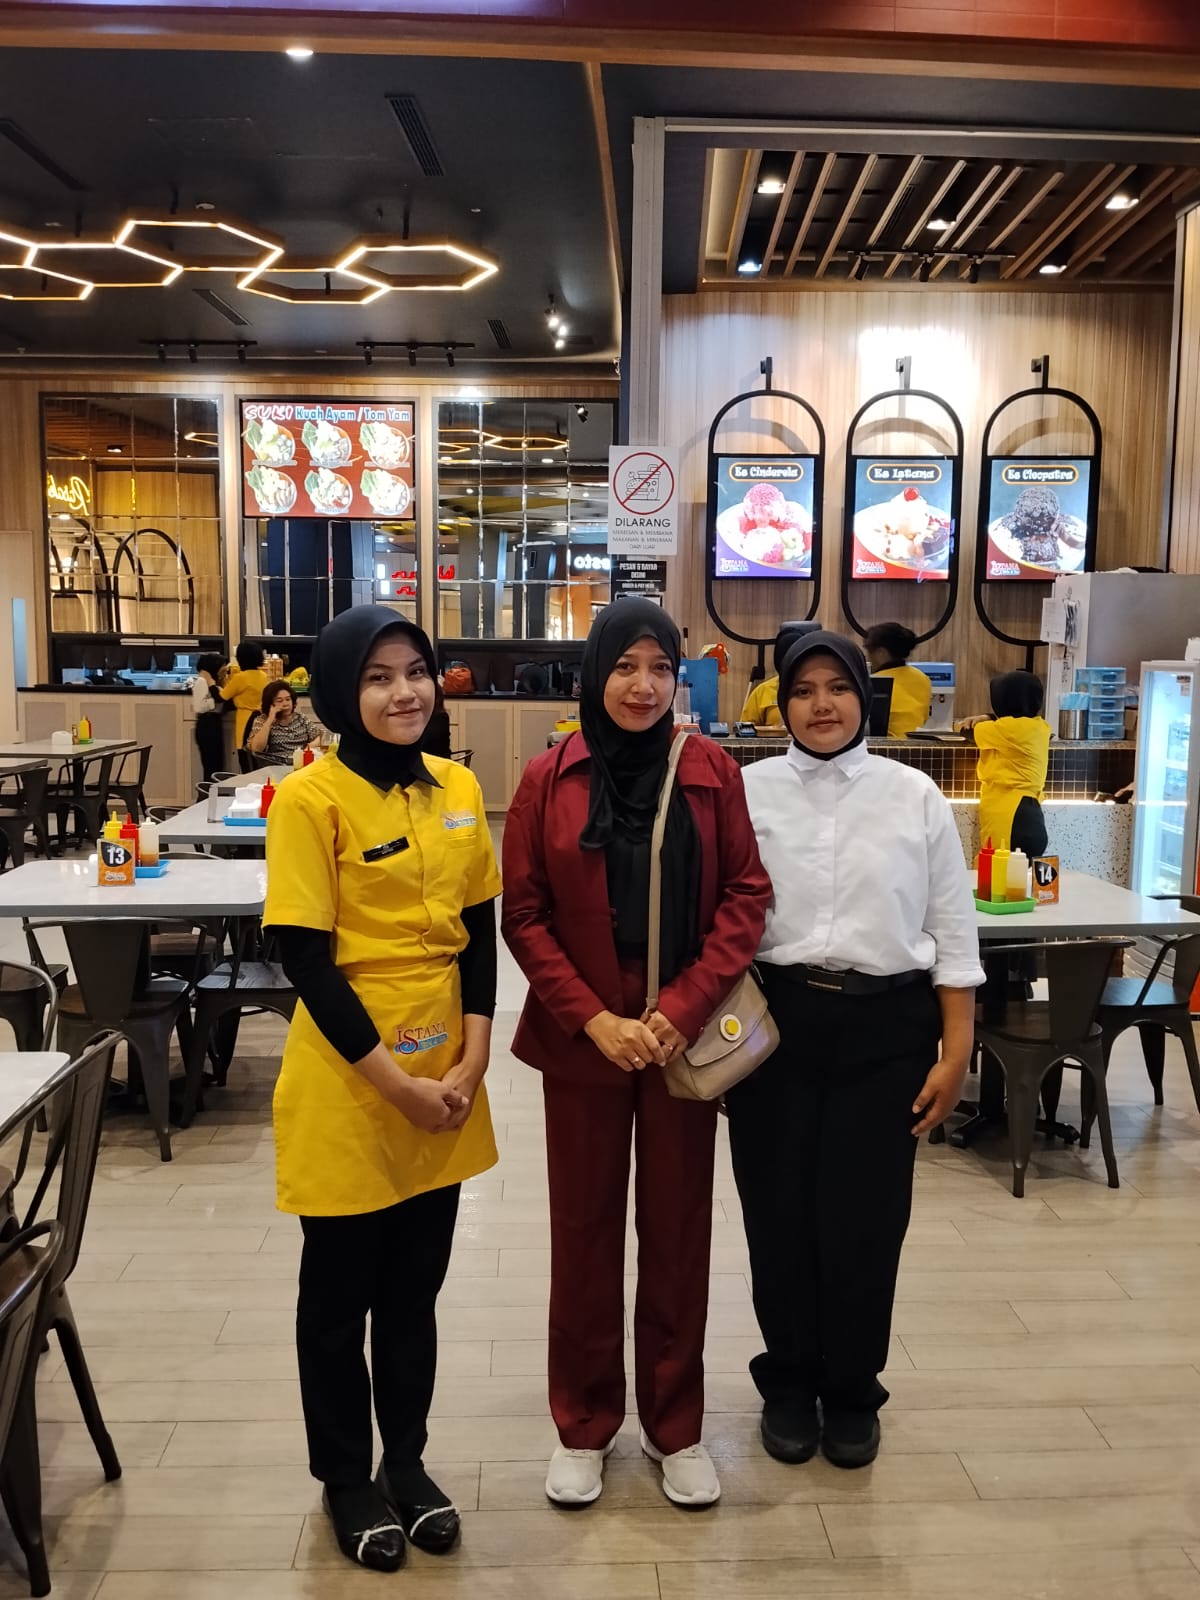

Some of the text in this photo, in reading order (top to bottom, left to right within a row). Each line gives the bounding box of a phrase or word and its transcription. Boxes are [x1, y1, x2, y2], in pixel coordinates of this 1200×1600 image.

[244, 405, 293, 420] SUKI
[295, 406, 324, 420] Kuah
[325, 407, 356, 423] Ayam
[388, 407, 410, 421] Yam
[735, 467, 798, 477] Es Cinderela
[874, 468, 935, 479] Es Istana
[1008, 469, 1074, 481] Es Cleopatra
[615, 517, 671, 528] DILARANG
[107, 846, 125, 865] 13
[1038, 865, 1053, 883] 14
